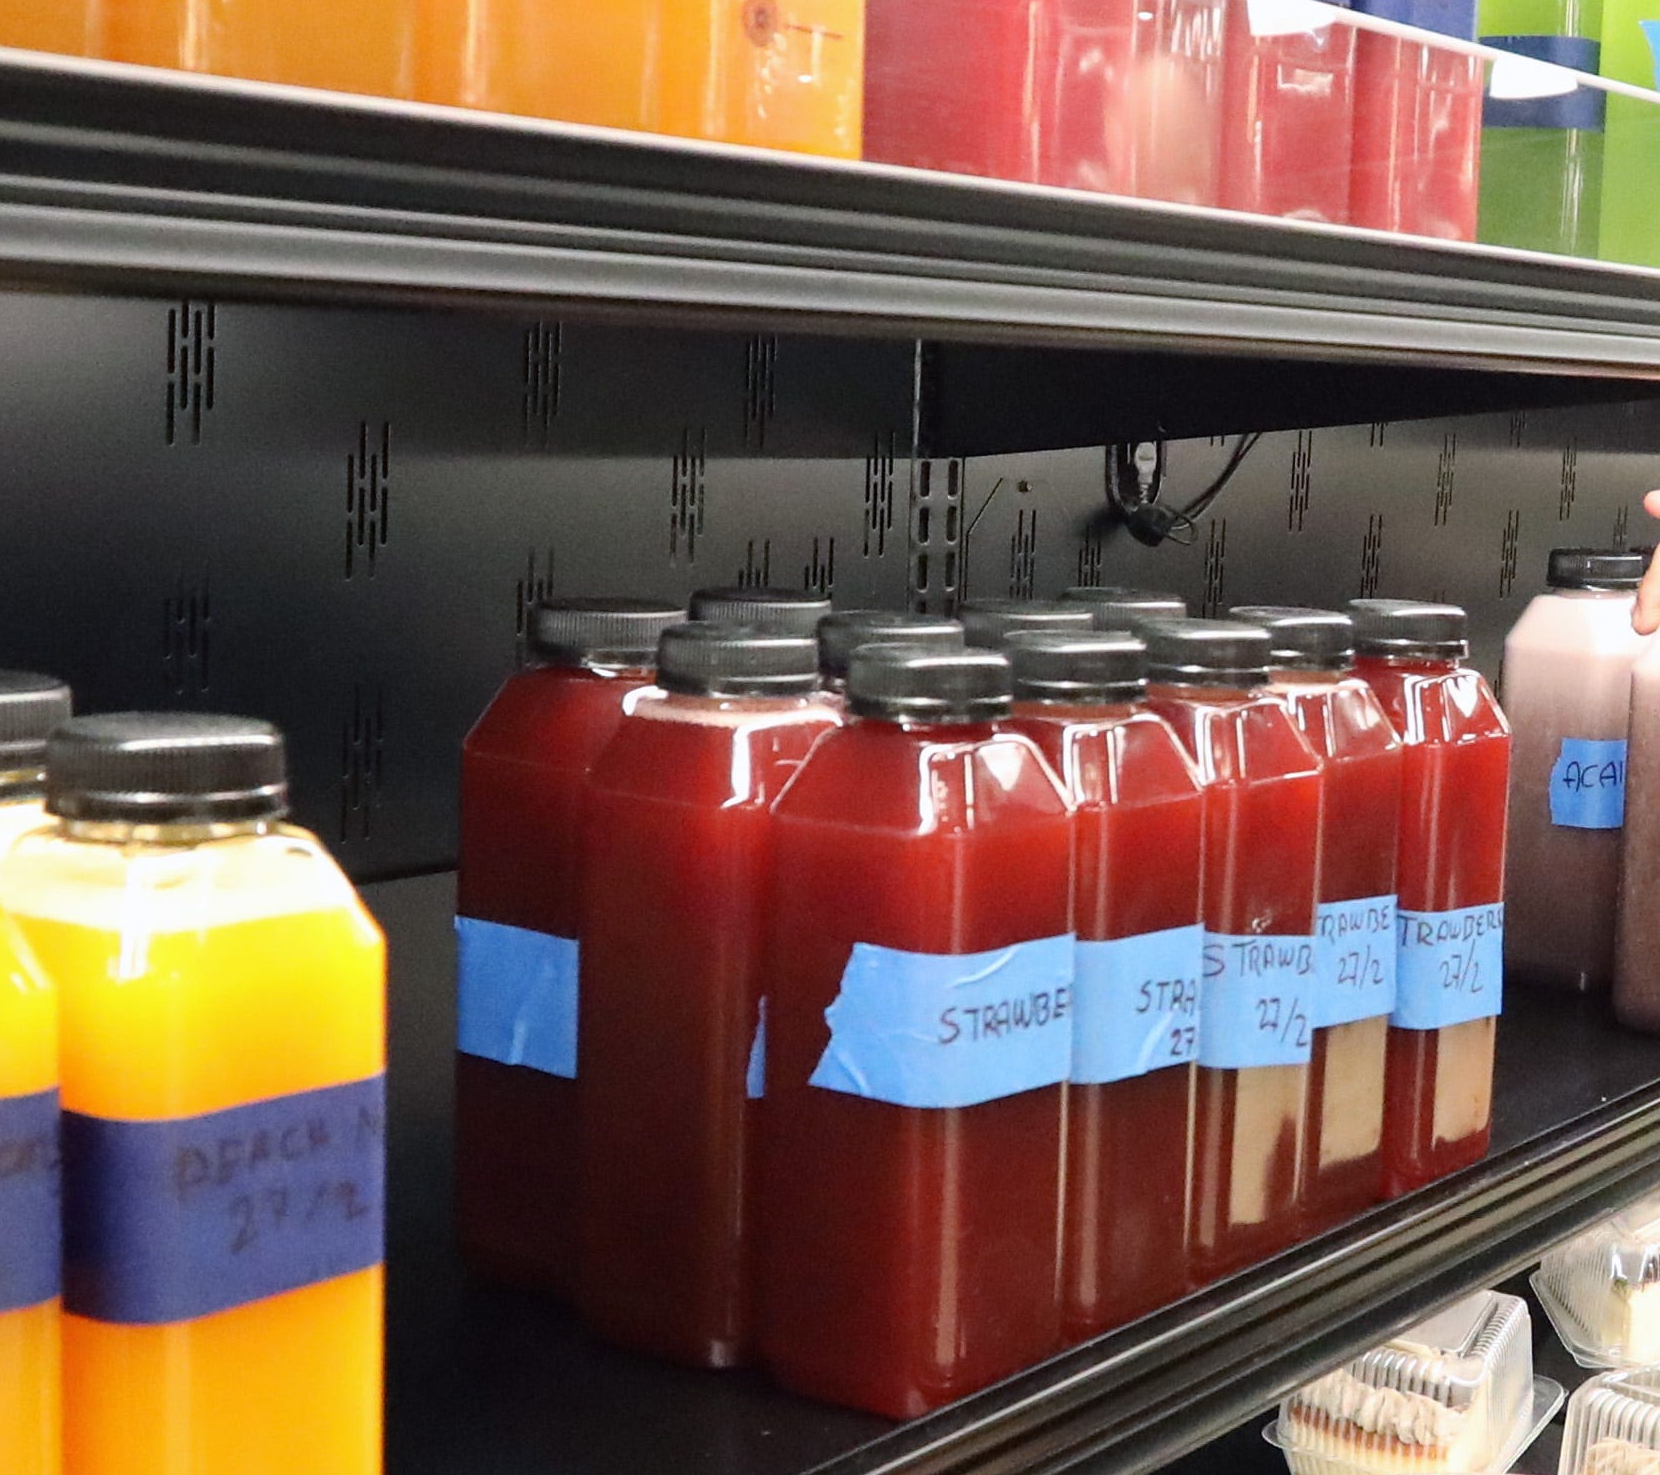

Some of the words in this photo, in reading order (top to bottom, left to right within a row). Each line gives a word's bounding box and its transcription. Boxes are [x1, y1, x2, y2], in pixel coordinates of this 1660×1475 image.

[1563, 760, 1623, 792] ACAI
[1337, 944, 1384, 990] 27/2
[1440, 938, 1483, 994] 27/2
[939, 985, 1072, 1045] STRAWBE
[1254, 996, 1309, 1048] 27/2
